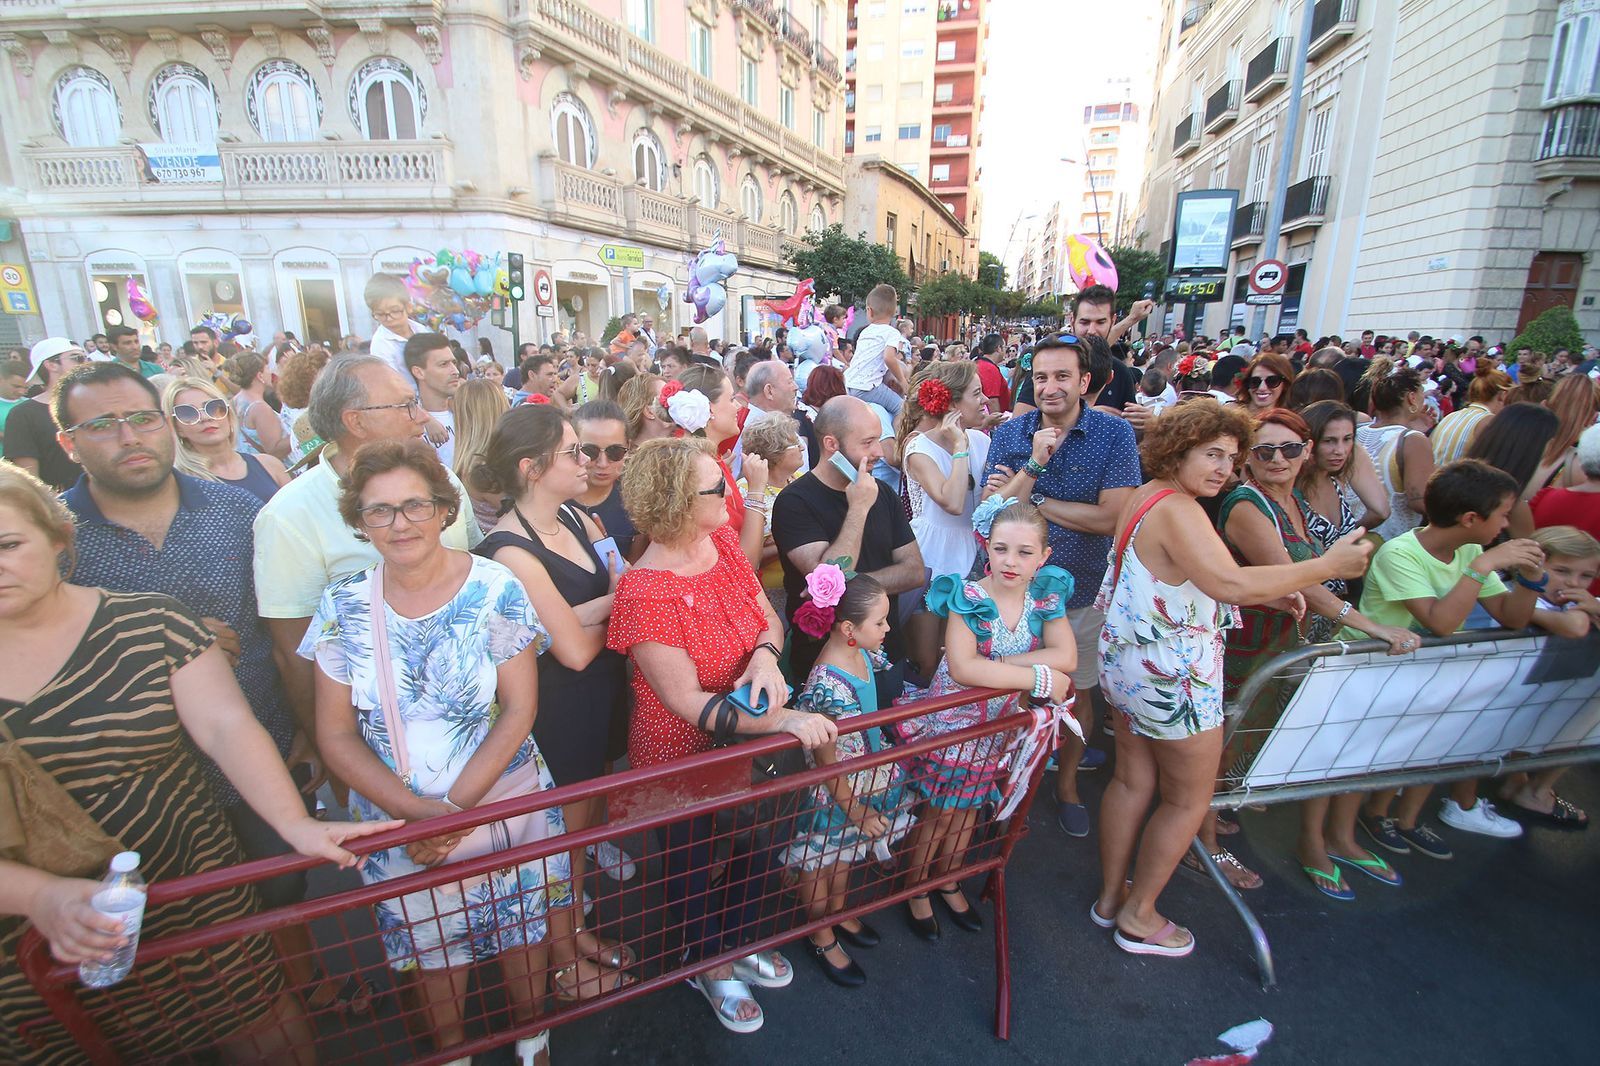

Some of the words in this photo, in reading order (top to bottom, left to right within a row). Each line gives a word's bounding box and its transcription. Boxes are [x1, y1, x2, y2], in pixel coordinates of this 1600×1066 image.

[157, 156, 199, 168] VENDE
[156, 168, 172, 178] 670
[173, 168, 189, 179] 730
[190, 168, 206, 178] 967
[5, 272, 18, 281] 30
[1178, 282, 1216, 295] 19:50
